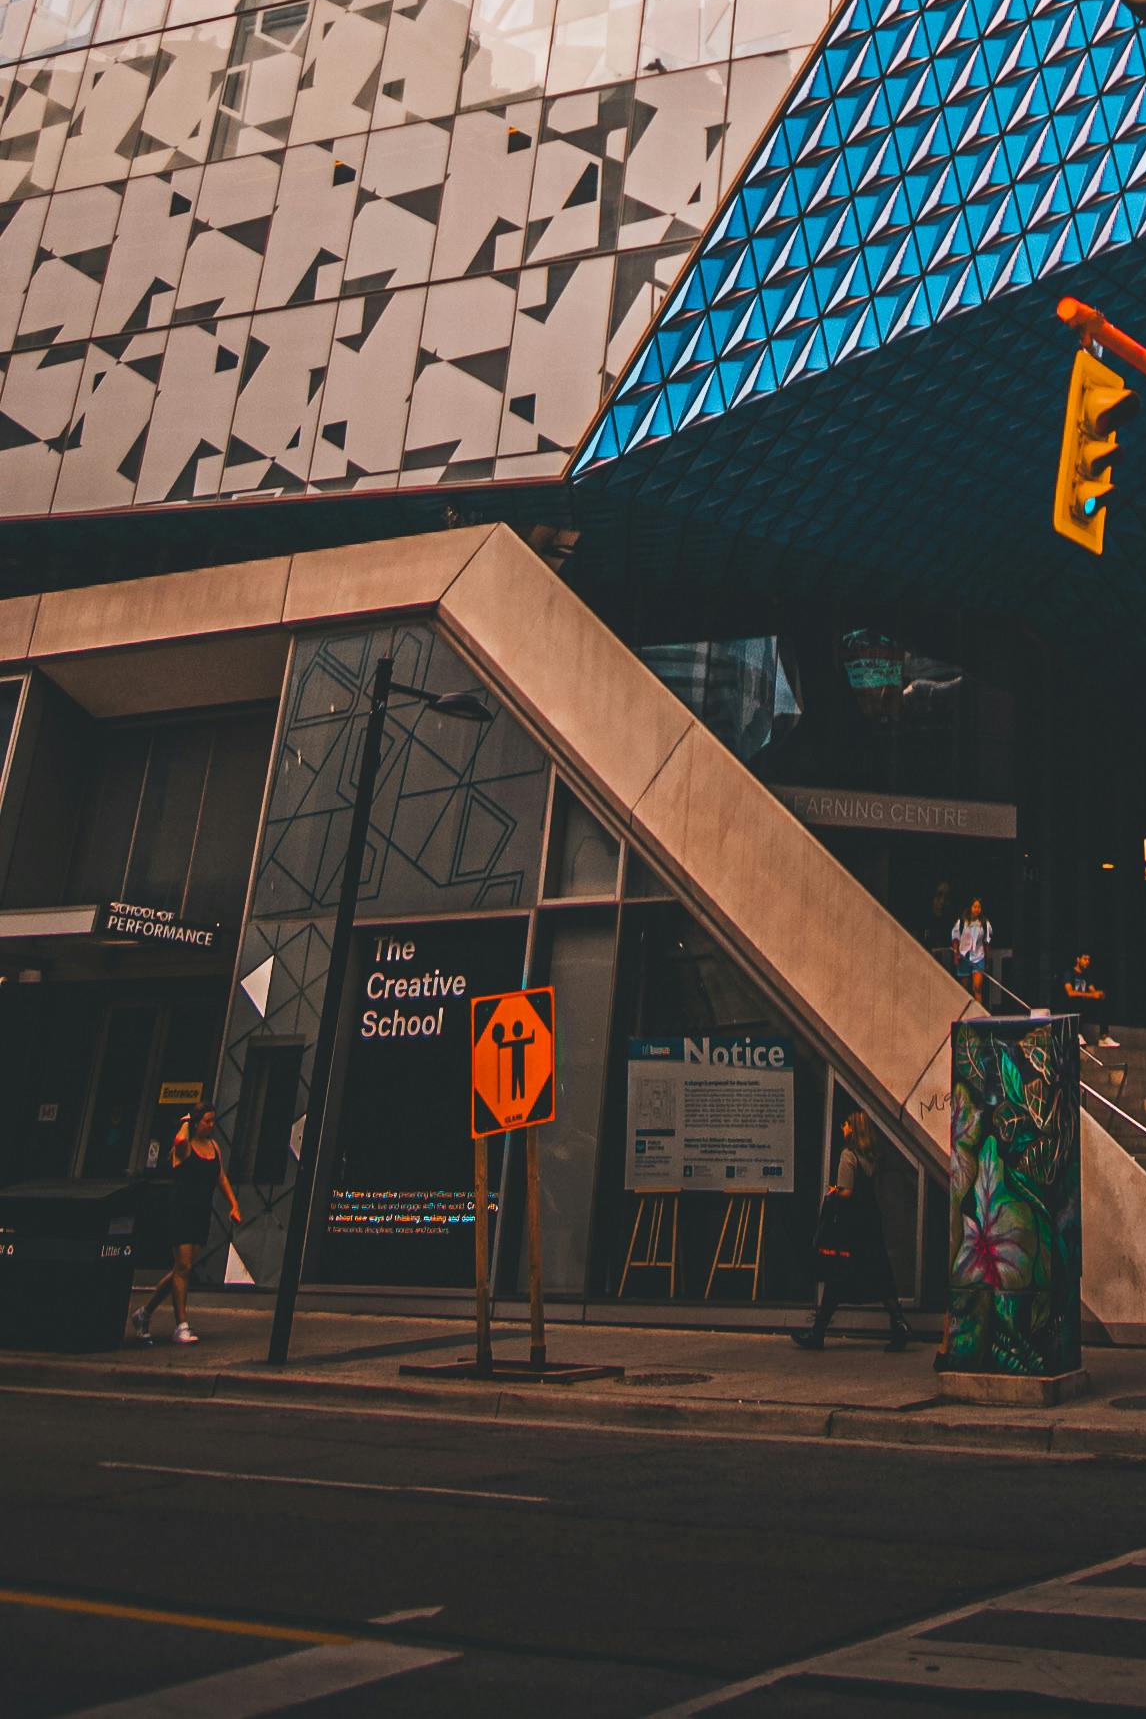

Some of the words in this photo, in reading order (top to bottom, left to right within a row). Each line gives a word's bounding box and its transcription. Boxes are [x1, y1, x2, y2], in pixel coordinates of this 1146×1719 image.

[890, 802, 968, 828] CENTRE
[110, 902, 157, 920] SCHOOL
[159, 910, 175, 922] OF
[107, 915, 214, 946] PERFORMANCE
[374, 936, 416, 962] The
[367, 969, 467, 999] Creative
[361, 1007, 444, 1037] School
[683, 1036, 785, 1067] Notice
[163, 1088, 200, 1099] Entrance
[333, 1189, 344, 1198] The
[345, 1189, 365, 1199] future
[372, 1189, 398, 1198] creative
[335, 1213, 353, 1222] about
[369, 1215, 384, 1224] ways
[423, 1214, 447, 1224] making
[447, 1213, 461, 1222] and
[462, 1213, 476, 1222] doin
[101, 1244, 121, 1258] Litter
